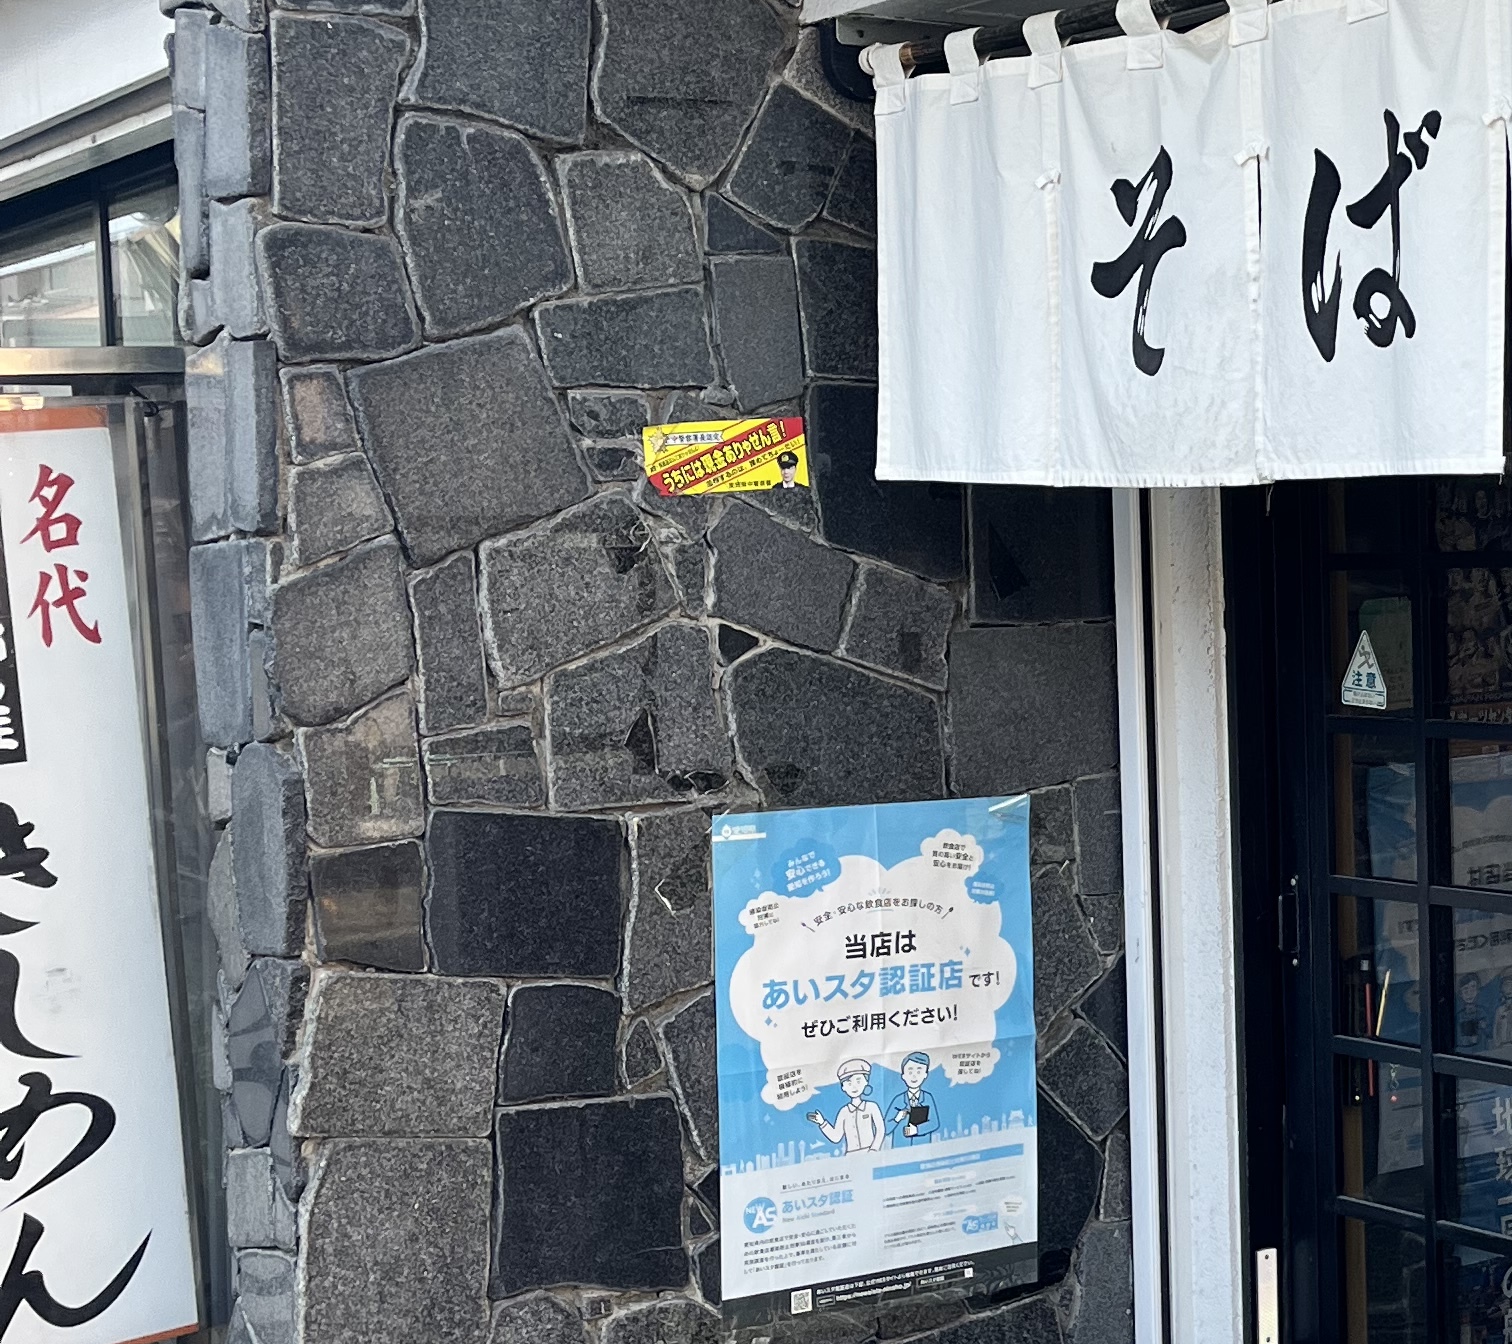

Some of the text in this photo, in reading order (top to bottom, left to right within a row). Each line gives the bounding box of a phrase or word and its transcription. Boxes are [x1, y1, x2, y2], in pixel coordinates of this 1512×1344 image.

[19, 464, 102, 648] 名代
[1351, 668, 1377, 690] 注意
[845, 930, 917, 960] 当店は
[761, 959, 1001, 1010] あいスタ認証店 です!
[801, 1004, 958, 1039] ぜひご利用ください!
[781, 1189, 855, 1214] あいスタ認証
[752, 1206, 777, 1228] AS
